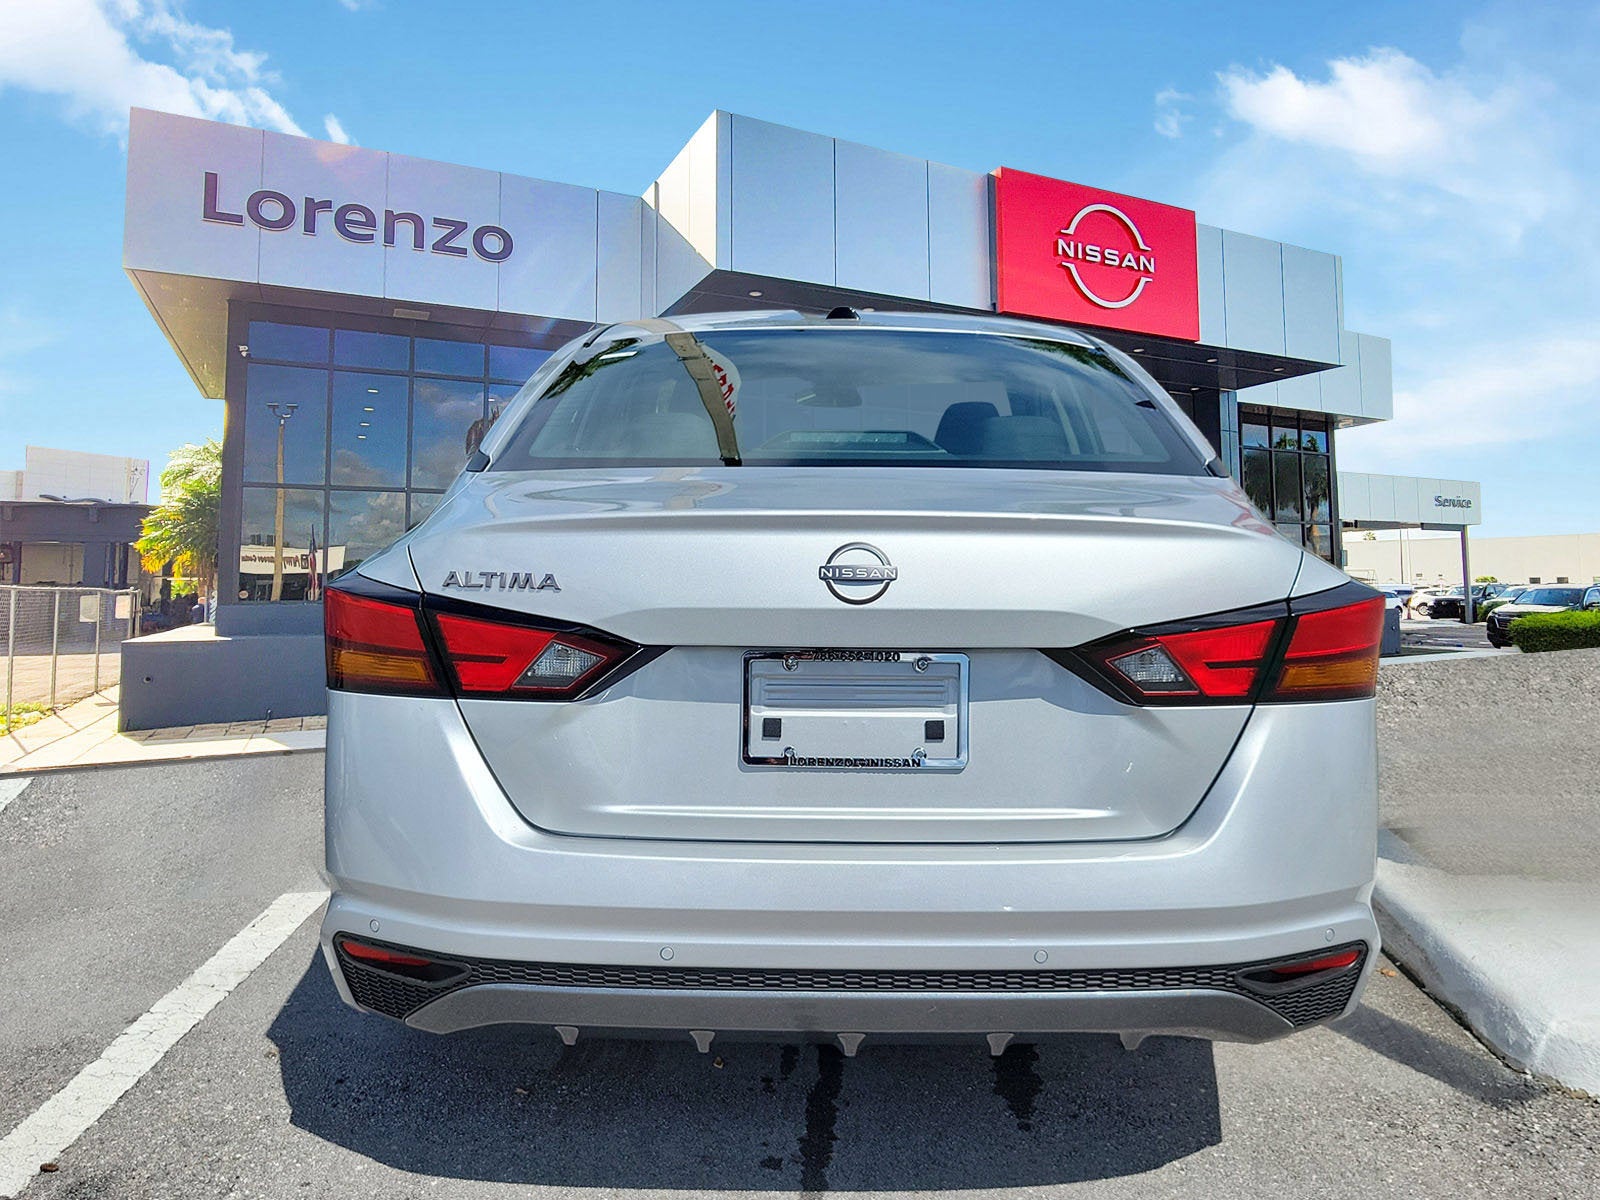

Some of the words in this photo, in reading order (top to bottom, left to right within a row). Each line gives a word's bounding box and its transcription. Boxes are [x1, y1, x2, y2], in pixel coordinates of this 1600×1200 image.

[203, 171, 514, 262] Lorenzo
[1057, 238, 1155, 273] NISSAN
[1434, 495, 1472, 509] Service
[442, 570, 562, 591] ALTIMA
[820, 568, 897, 578] NISSAN
[790, 757, 854, 767] LORENZO
[870, 758, 920, 767] NISSAN
